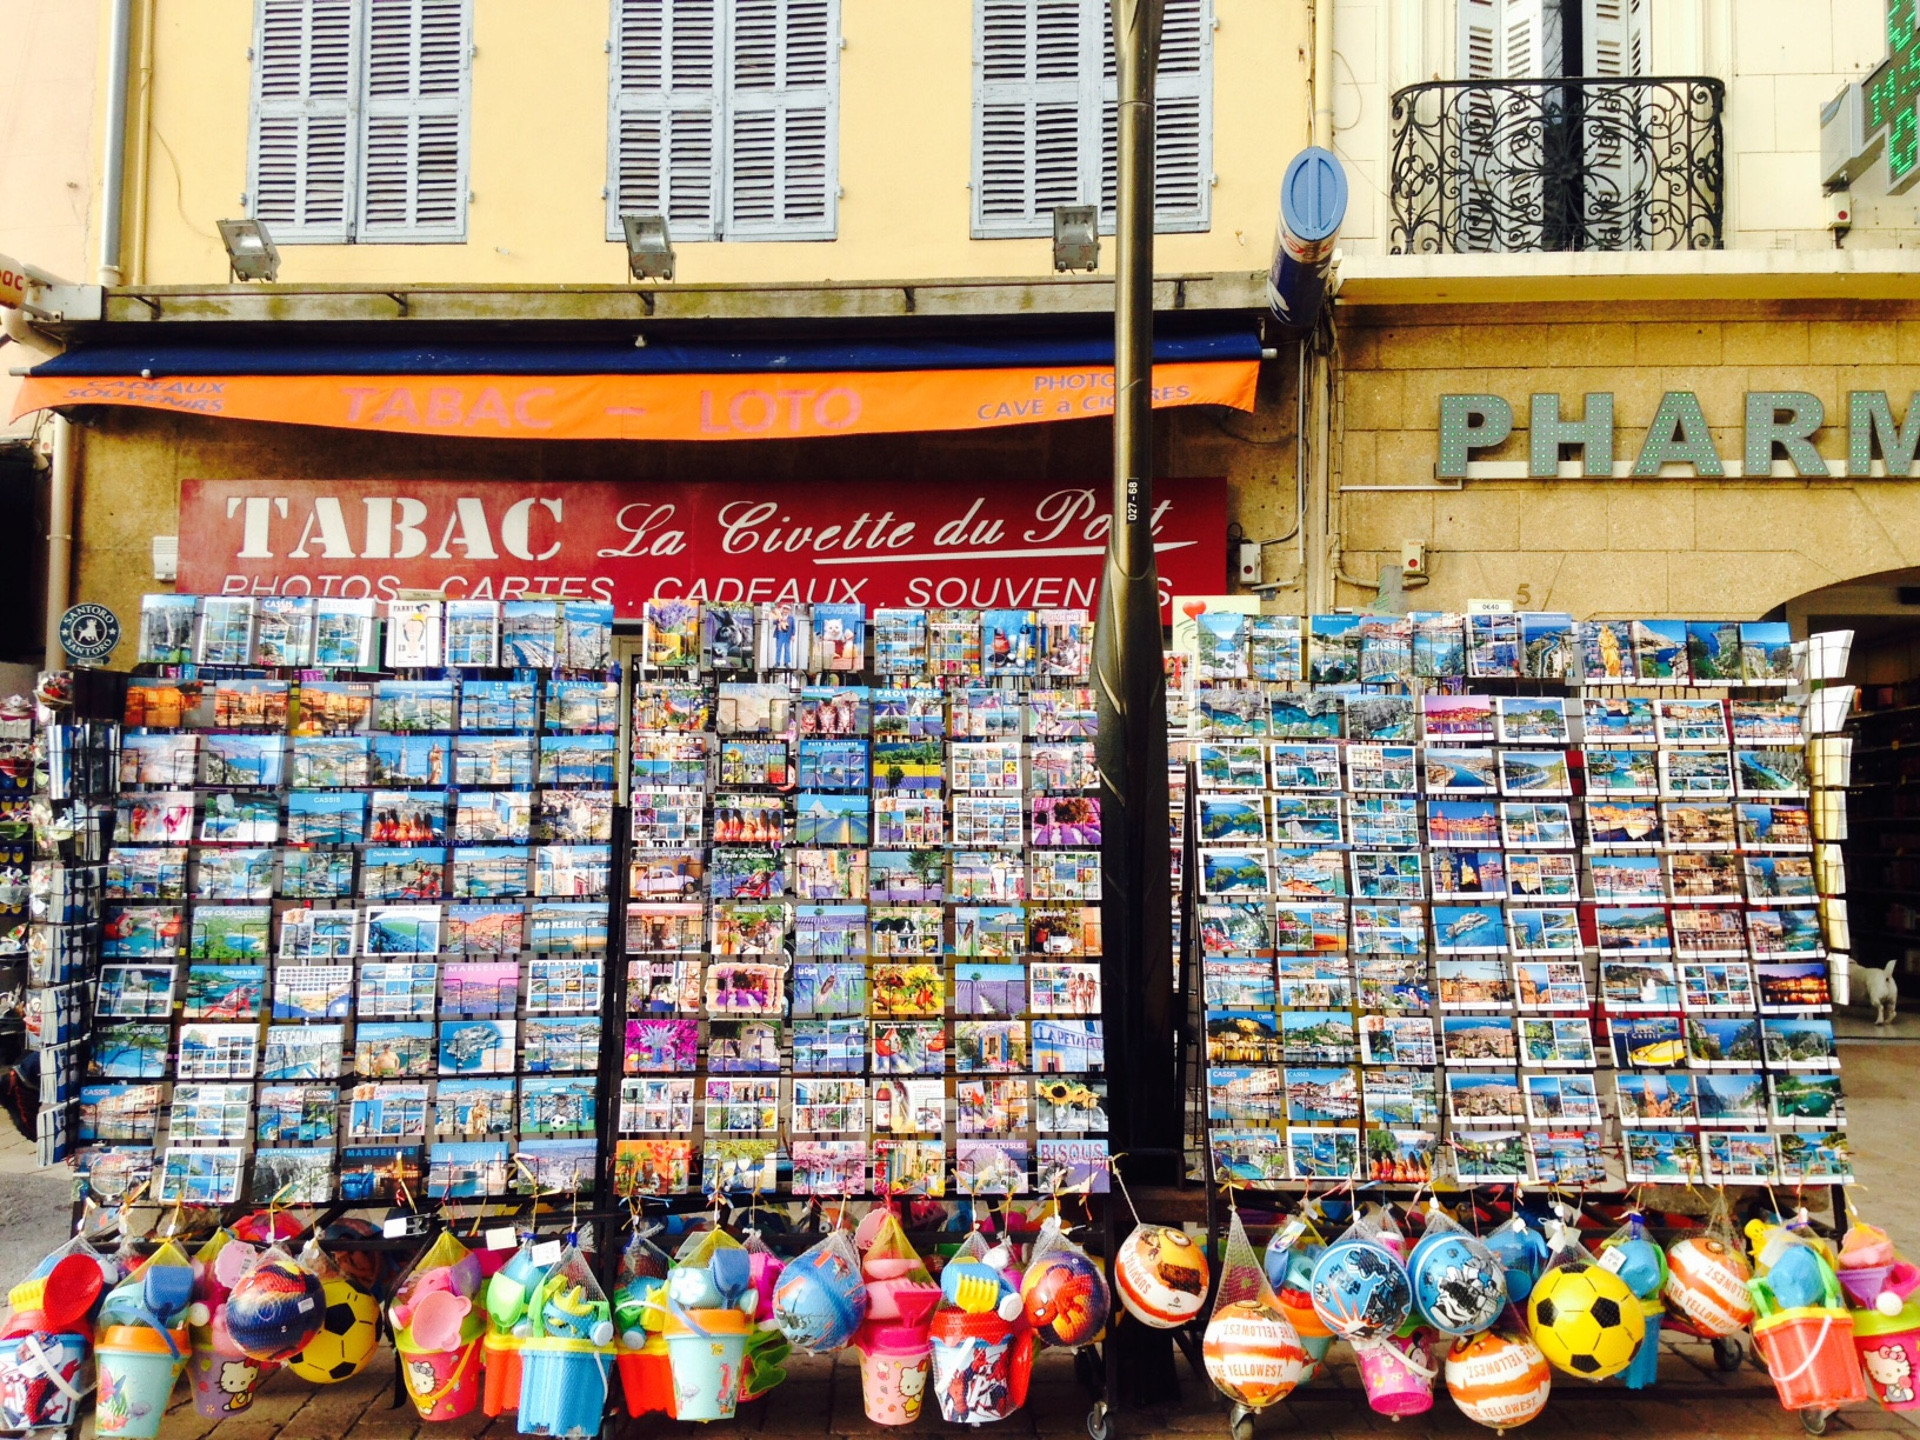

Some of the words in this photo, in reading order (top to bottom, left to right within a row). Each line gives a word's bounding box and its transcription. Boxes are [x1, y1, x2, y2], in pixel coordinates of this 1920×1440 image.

[0, 270, 24, 292] ac
[87, 380, 227, 394] CADEAUX
[1033, 373, 1115, 391] PHOTO
[63, 388, 225, 413] SOUVENIRS
[340, 385, 560, 430] TABAC
[699, 387, 863, 434] LOTO
[977, 399, 1044, 420] CAVE
[1082, 385, 1190, 411] CIGRES
[226, 496, 563, 561] TABAC
[596, 502, 687, 558] La
[717, 500, 916, 554] Civette
[933, 497, 1006, 547] du
[1023, 487, 1174, 543] Pot
[221, 575, 400, 603] PHOTOS
[436, 575, 614, 603] CARTES
[653, 577, 869, 606] CADEAUX
[903, 577, 1173, 608] SOUVENS
[264, 599, 294, 608] CASSIS
[63, 605, 115, 625] SANTORO
[64, 638, 113, 656] SANTORO
[1368, 639, 1408, 650] CASSIS
[876, 690, 941, 698] PROVENCE
[448, 964, 516, 972] MARSEILLE
[83, 1088, 110, 1096] CASSIS
[706, 1142, 776, 1150] PROVENCE
[1041, 1143, 1103, 1163] BISOUS
[1704, 1264, 1751, 1303] ELLOWEST.
